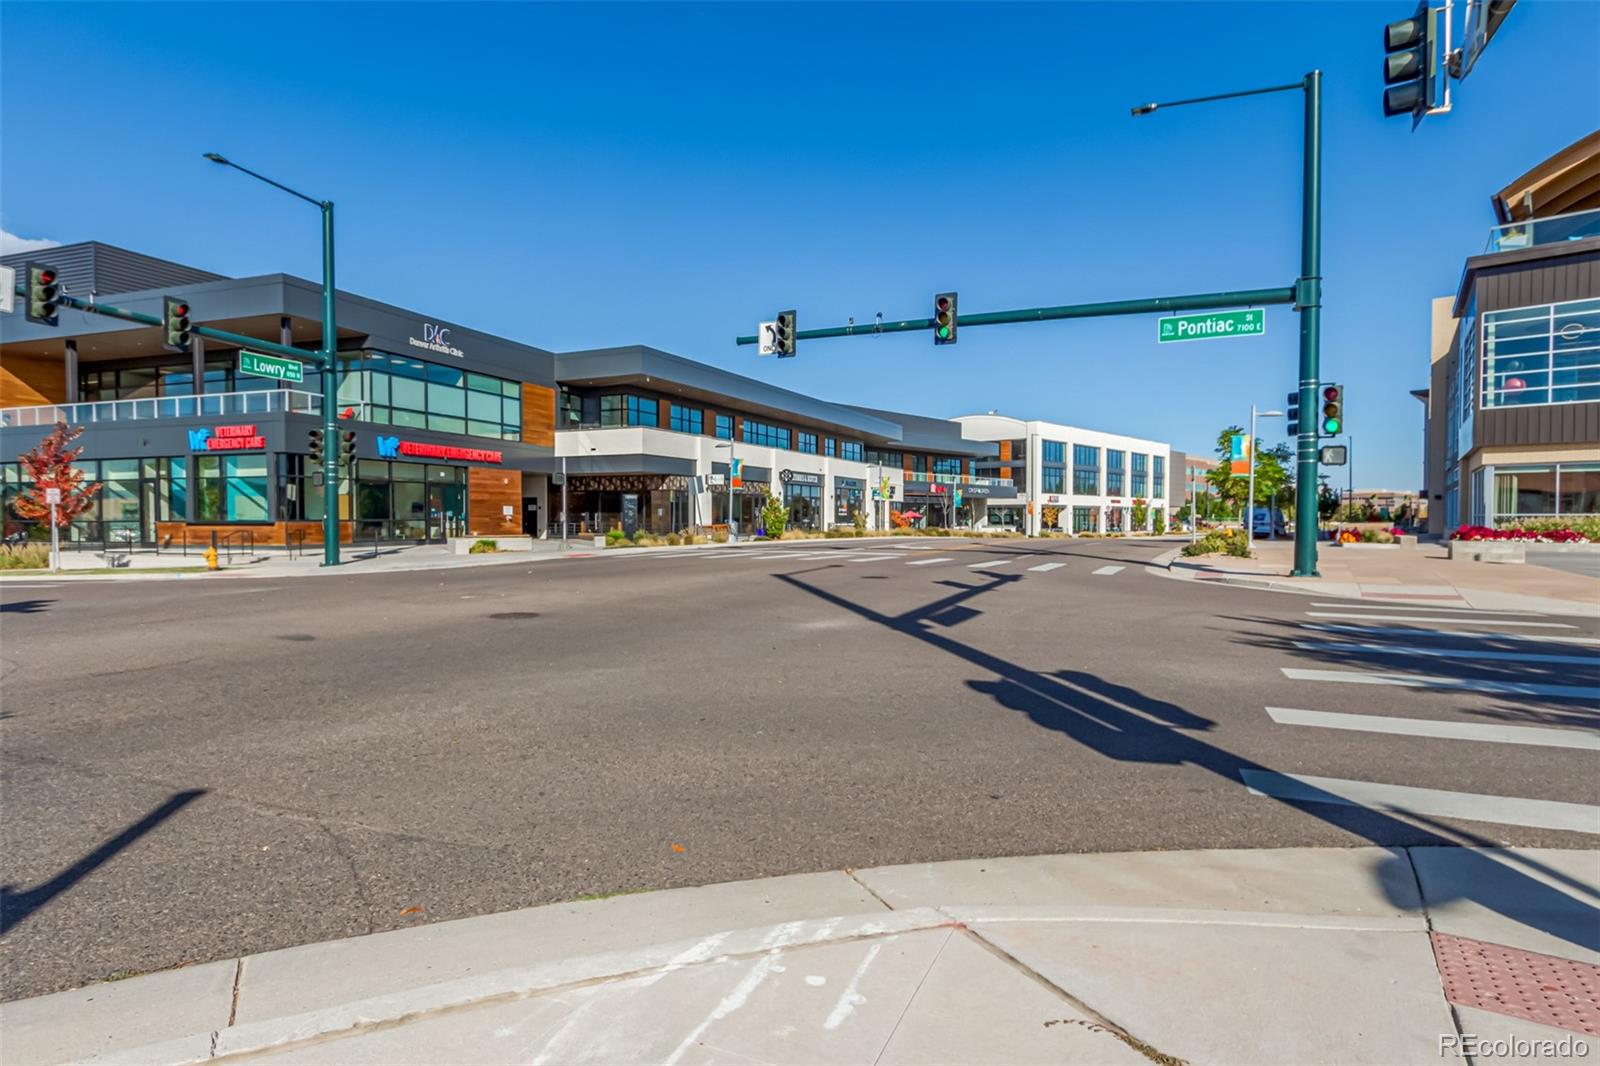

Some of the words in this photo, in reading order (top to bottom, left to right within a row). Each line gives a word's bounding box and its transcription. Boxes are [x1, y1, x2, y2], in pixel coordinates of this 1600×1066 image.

[1178, 318, 1234, 336] Pontiac
[409, 336, 429, 349] Denver
[450, 347, 465, 358] Clinic
[254, 358, 285, 378] Lowry
[215, 425, 256, 439] VETERINARY
[207, 437, 245, 450] EMERGENCY
[245, 436, 266, 449] CARE
[400, 441, 446, 459] VETERINARY
